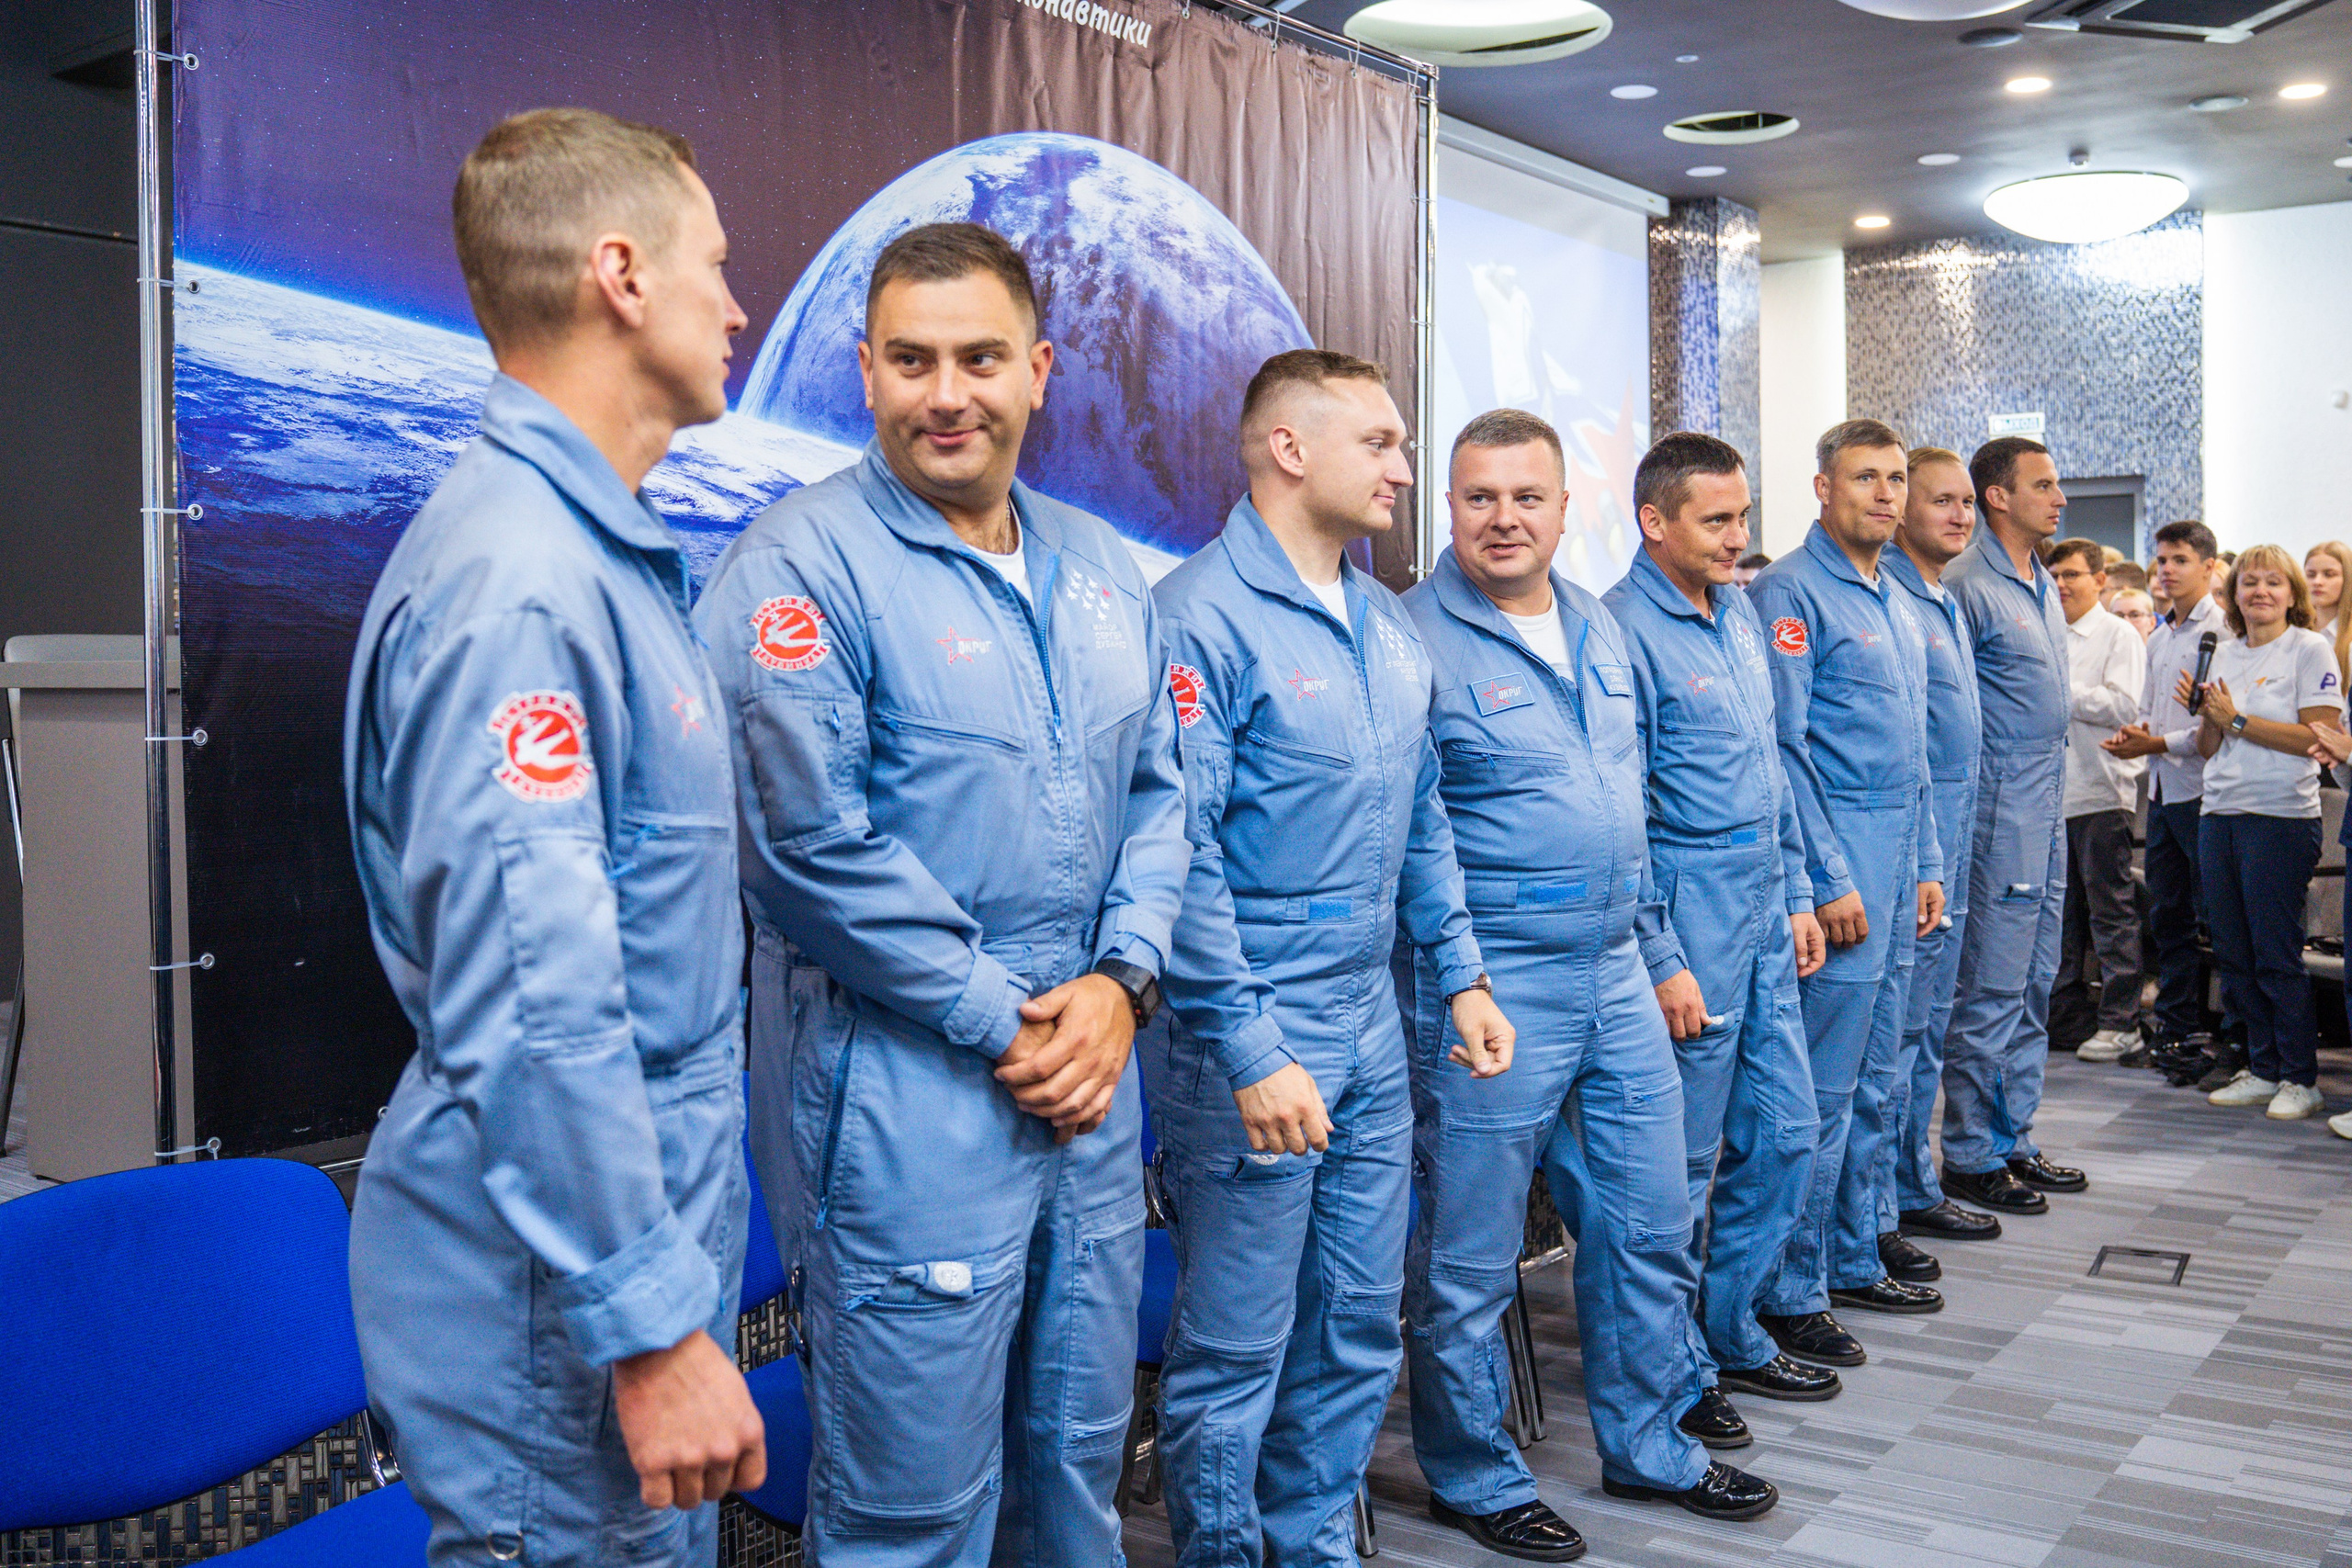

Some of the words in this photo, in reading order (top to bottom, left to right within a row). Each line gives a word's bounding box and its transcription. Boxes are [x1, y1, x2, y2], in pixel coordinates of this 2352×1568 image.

[1016, 0, 1152, 48] навтики
[1994, 417, 2038, 432] ЫХОД
[958, 640, 992, 654] ОКРУГ
[1304, 679, 1329, 692] ОКРУГ
[1498, 686, 1522, 699] ОКРУГ
